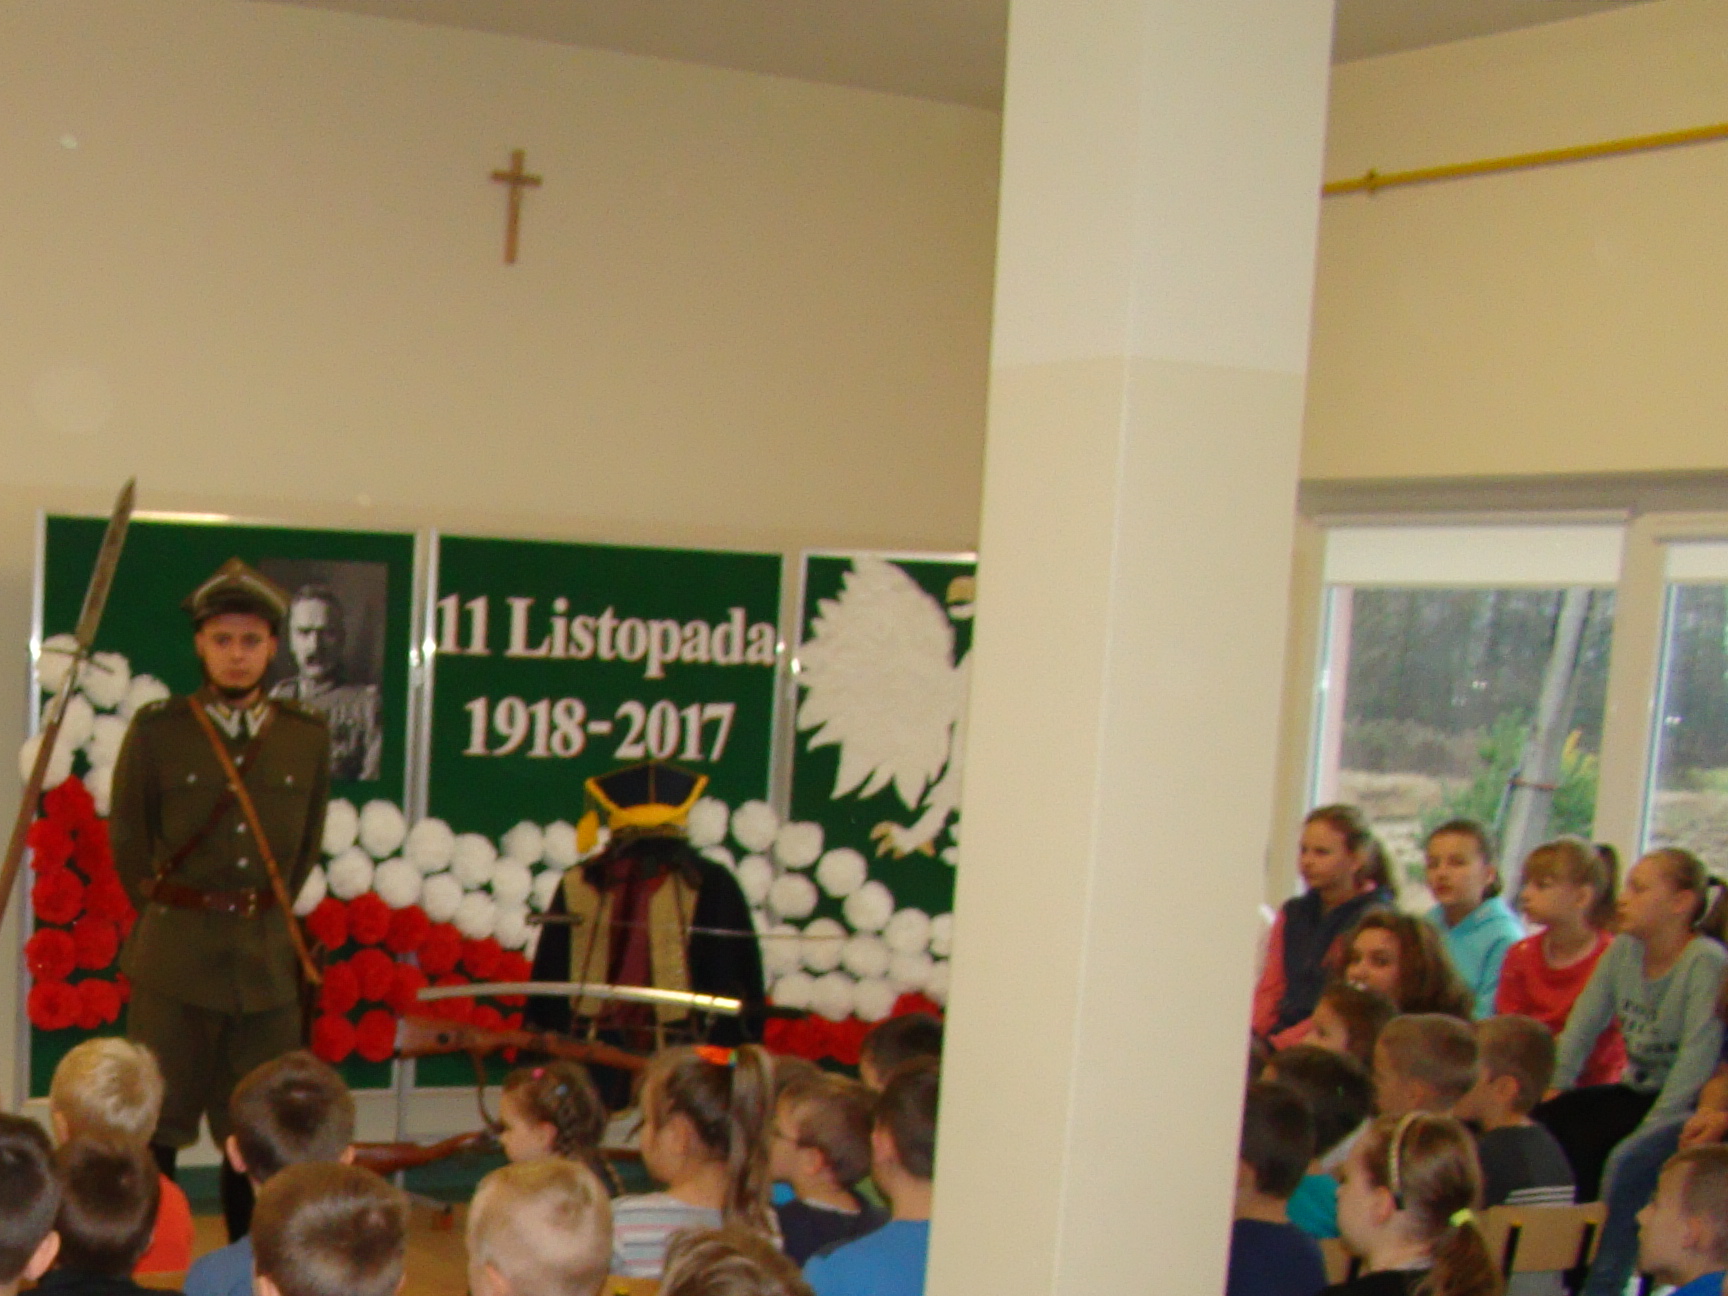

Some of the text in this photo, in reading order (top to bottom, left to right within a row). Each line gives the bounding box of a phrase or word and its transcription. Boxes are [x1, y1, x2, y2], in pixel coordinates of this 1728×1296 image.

[436, 593, 777, 679] 11 Listopada
[462, 696, 736, 763] 1918-2017
